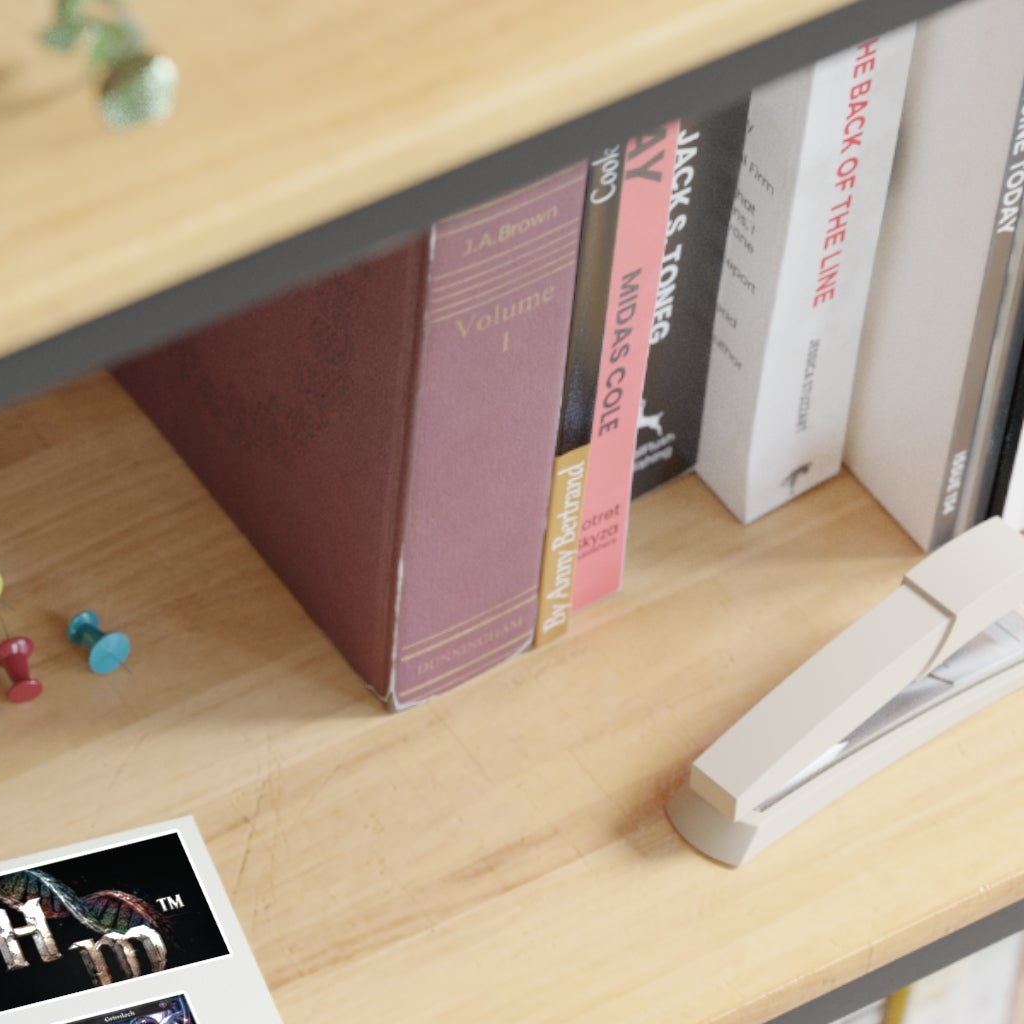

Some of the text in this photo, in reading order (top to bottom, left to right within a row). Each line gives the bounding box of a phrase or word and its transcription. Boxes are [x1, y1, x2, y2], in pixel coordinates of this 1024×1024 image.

[840, 78, 872, 154] BACK
[590, 145, 619, 204] Cook
[835, 157, 858, 191] OF
[823, 194, 852, 250] THE
[812, 250, 842, 308] LINE
[457, 287, 555, 338] Volume
[598, 267, 642, 437] MIDAS COLE
[551, 460, 585, 551] Bertrand
[542, 603, 566, 633] By
[157, 894, 185, 912] TM
